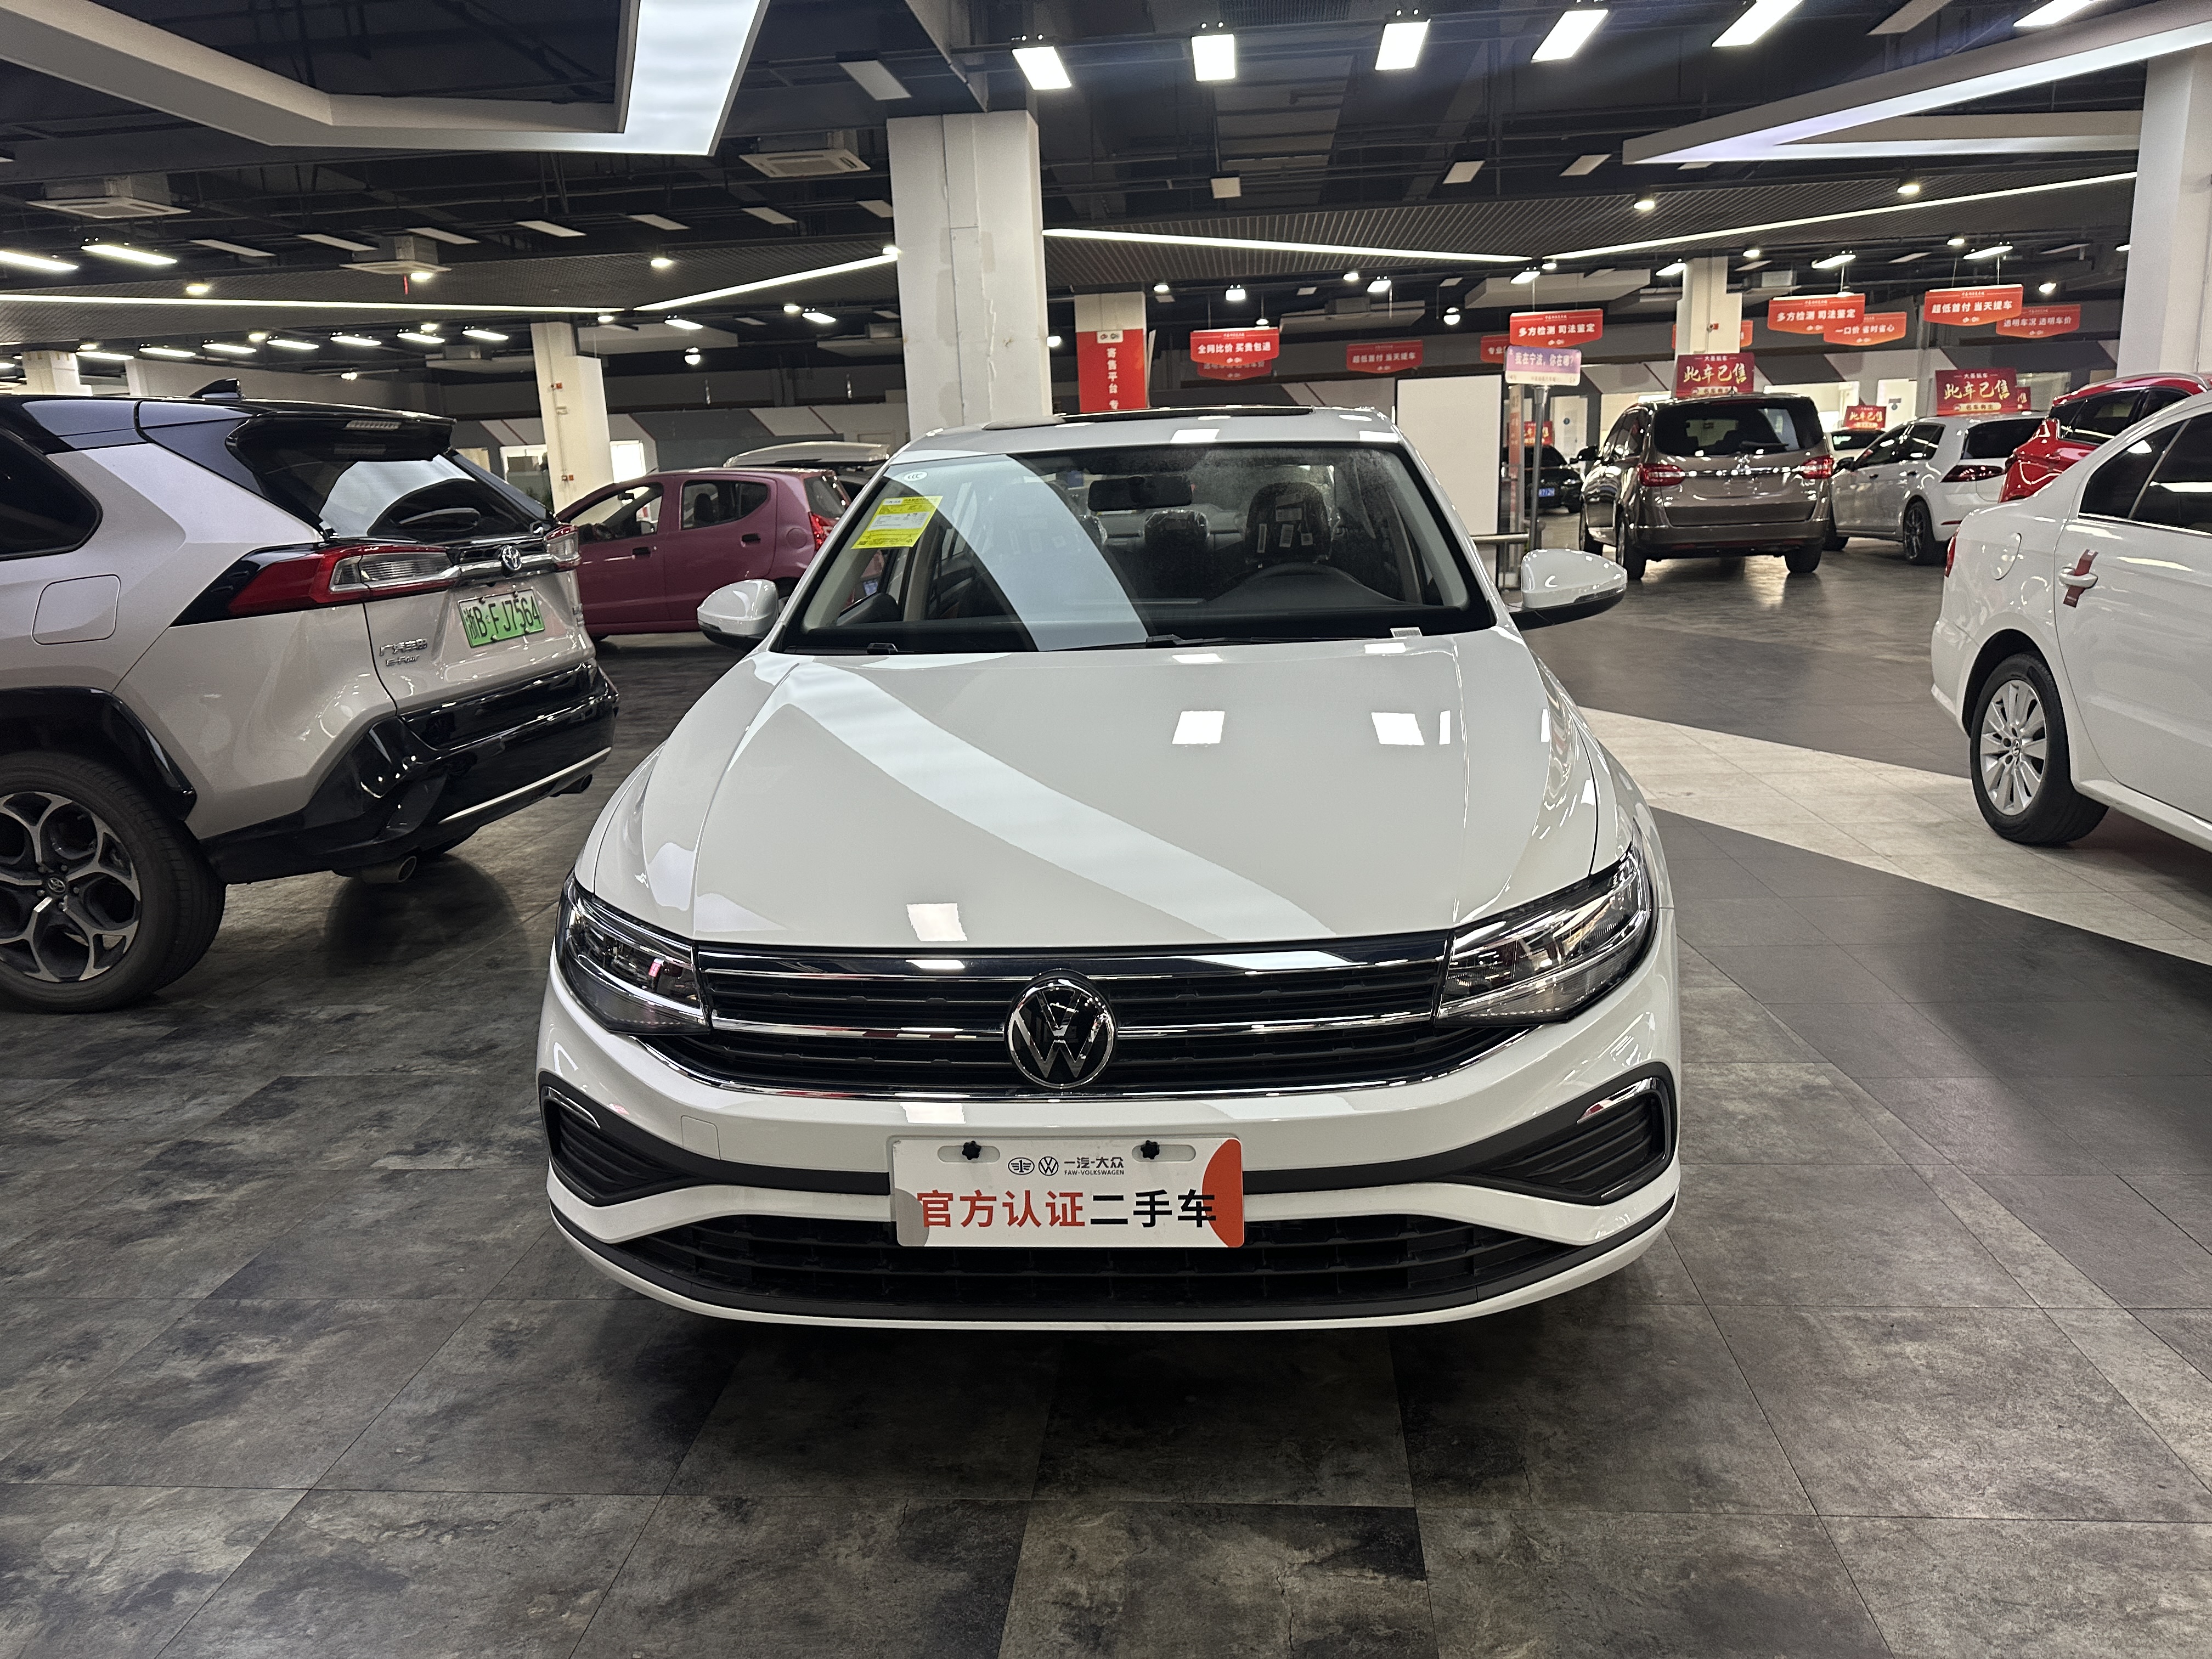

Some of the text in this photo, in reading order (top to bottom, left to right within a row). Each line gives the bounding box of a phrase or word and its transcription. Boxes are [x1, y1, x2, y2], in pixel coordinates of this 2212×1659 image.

[1932, 300, 2012, 313] 超低首付 当天提车
[1776, 311, 1815, 321] 多方检测
[1818, 308, 1856, 319] 司法鉴定
[2004, 316, 2072, 328] 透明车况 透明车价
[1518, 323, 1595, 337] 多方检测 司法鉴定
[1835, 324, 1895, 335] 一口价 省时省心
[1198, 343, 1233, 354] 全网比价
[1683, 362, 1747, 384] 此车已售
[1944, 379, 2010, 400] 此车已售
[1064, 1156, 1124, 1169] 一汽-大众
[917, 1189, 1216, 1228] 官方认证二手车
